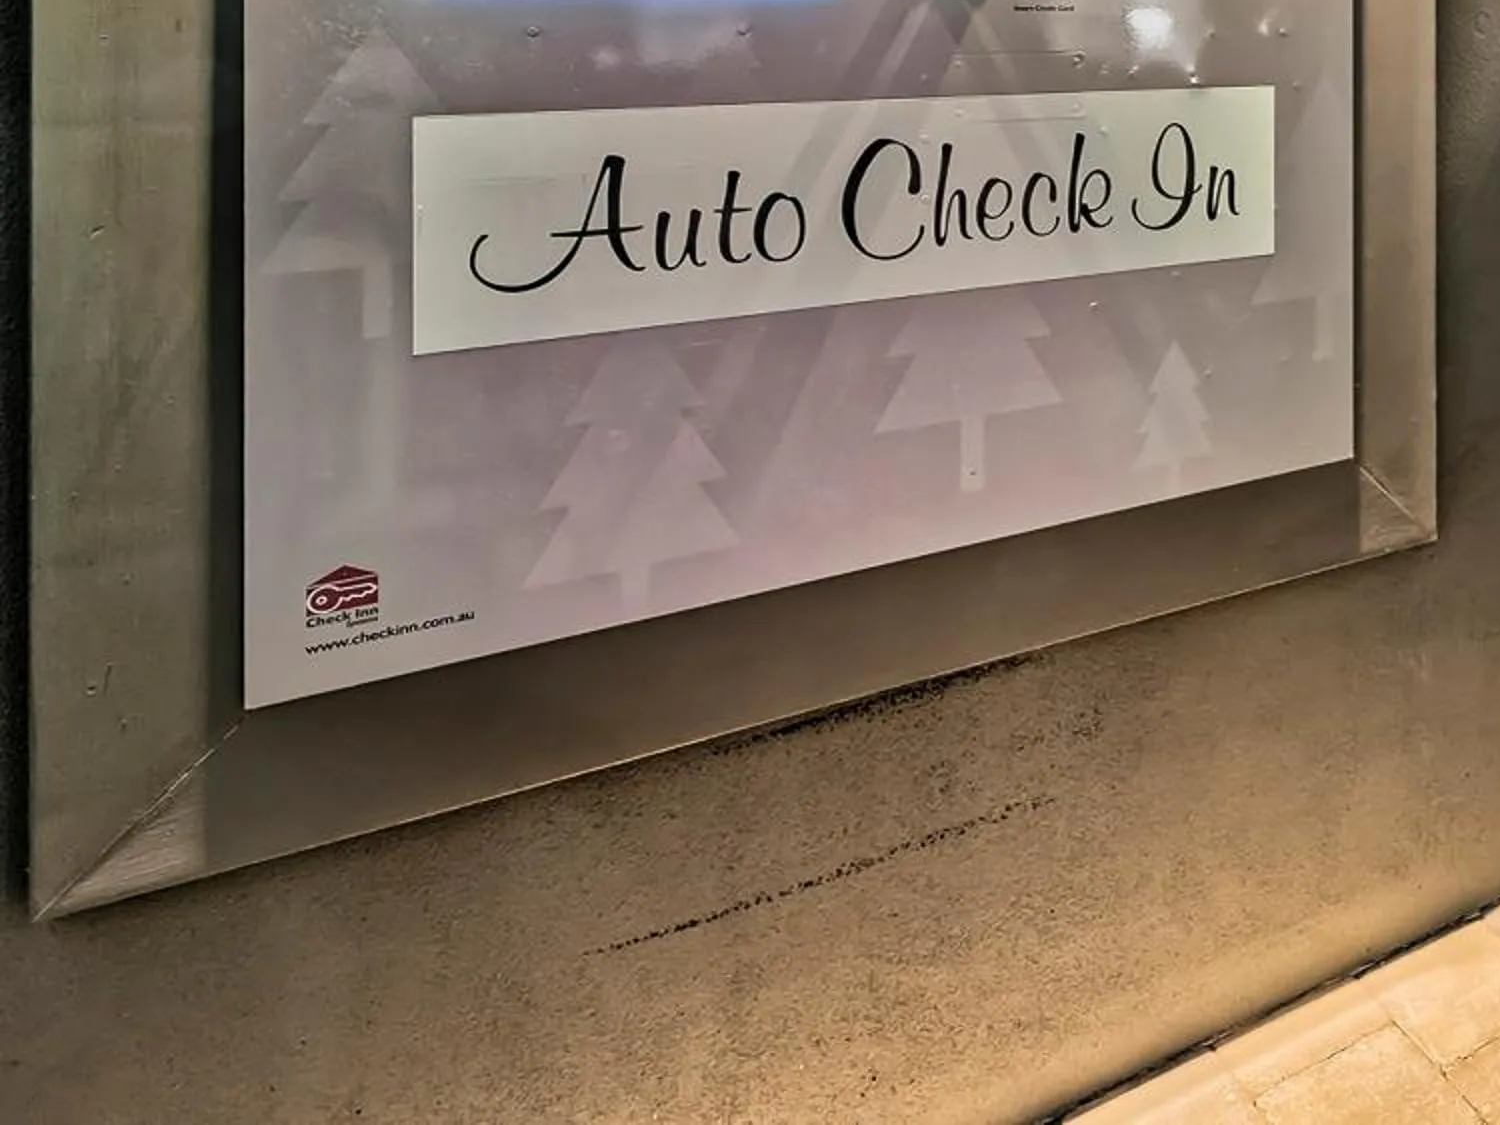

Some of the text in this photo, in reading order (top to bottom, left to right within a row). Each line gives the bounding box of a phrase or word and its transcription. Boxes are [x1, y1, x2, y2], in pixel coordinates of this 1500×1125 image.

[469, 121, 1241, 295] Auto Check In
[304, 610, 476, 656] www.checkinn.com.au
[306, 610, 351, 628] Check
